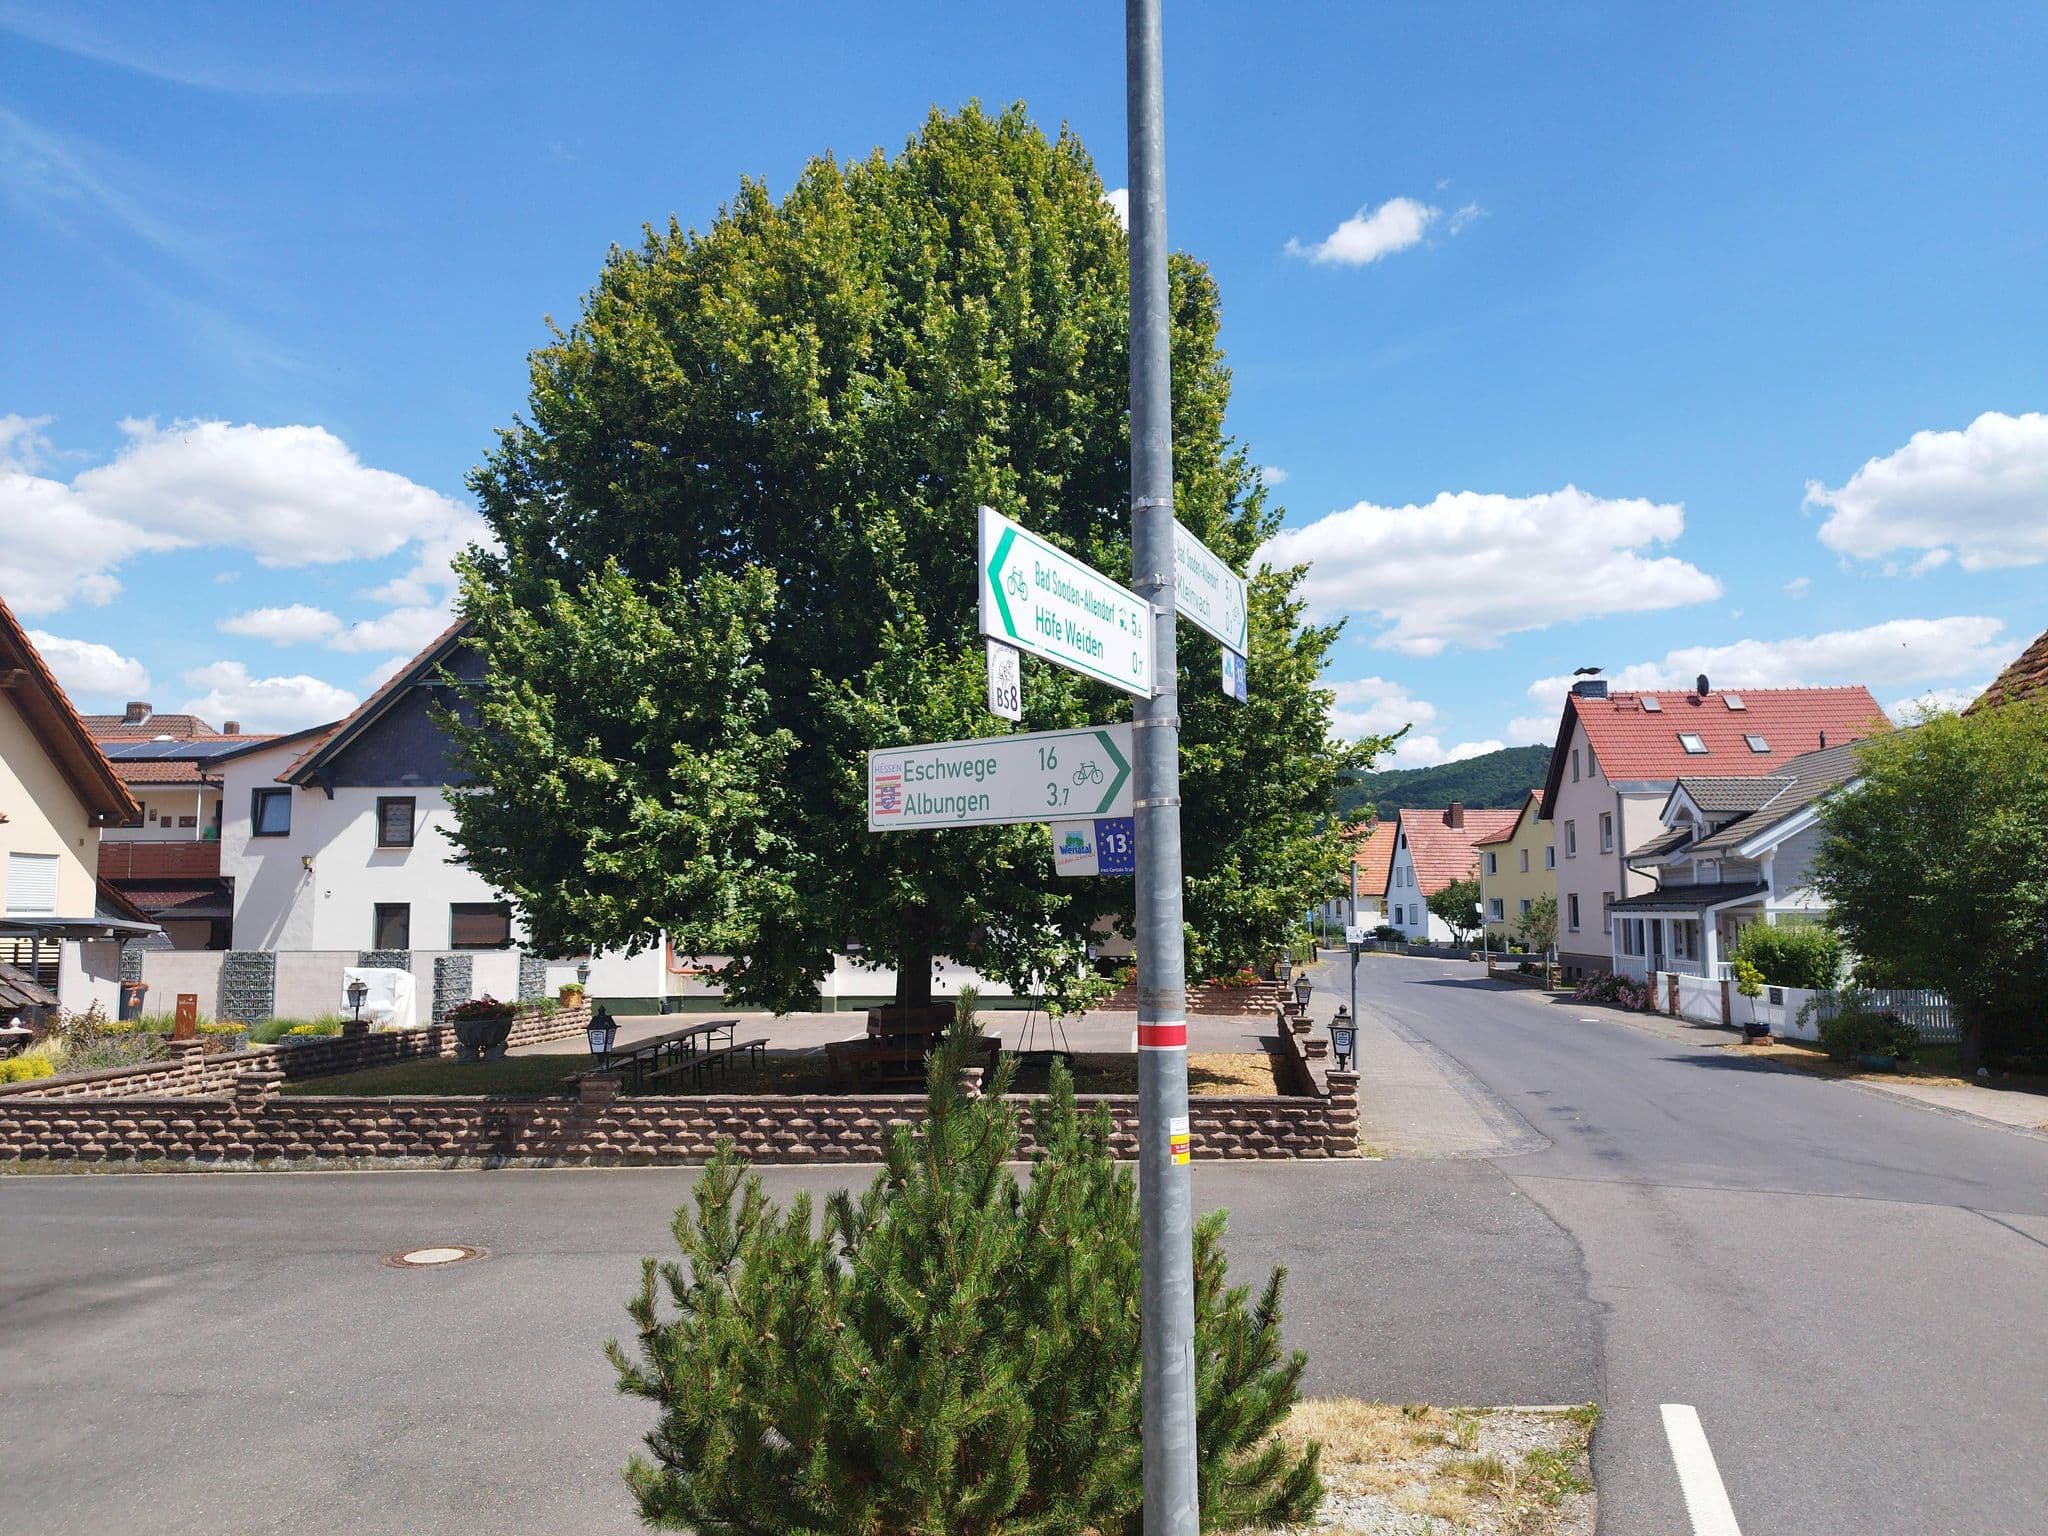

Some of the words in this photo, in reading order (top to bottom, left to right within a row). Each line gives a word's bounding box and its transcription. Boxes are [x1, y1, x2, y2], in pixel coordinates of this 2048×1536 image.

[1035, 561, 1050, 592] Bad
[1053, 570, 1115, 624] Sooden-Allendorf
[1035, 605, 1063, 641] Höfe
[1065, 618, 1104, 660] Weiden
[997, 685, 1018, 712] BS8
[874, 762, 902, 774] HESSEN
[904, 757, 997, 783] Eschwege
[1038, 746, 1058, 771] 16
[903, 792, 990, 819] Albungen
[1105, 833, 1128, 854] 13
